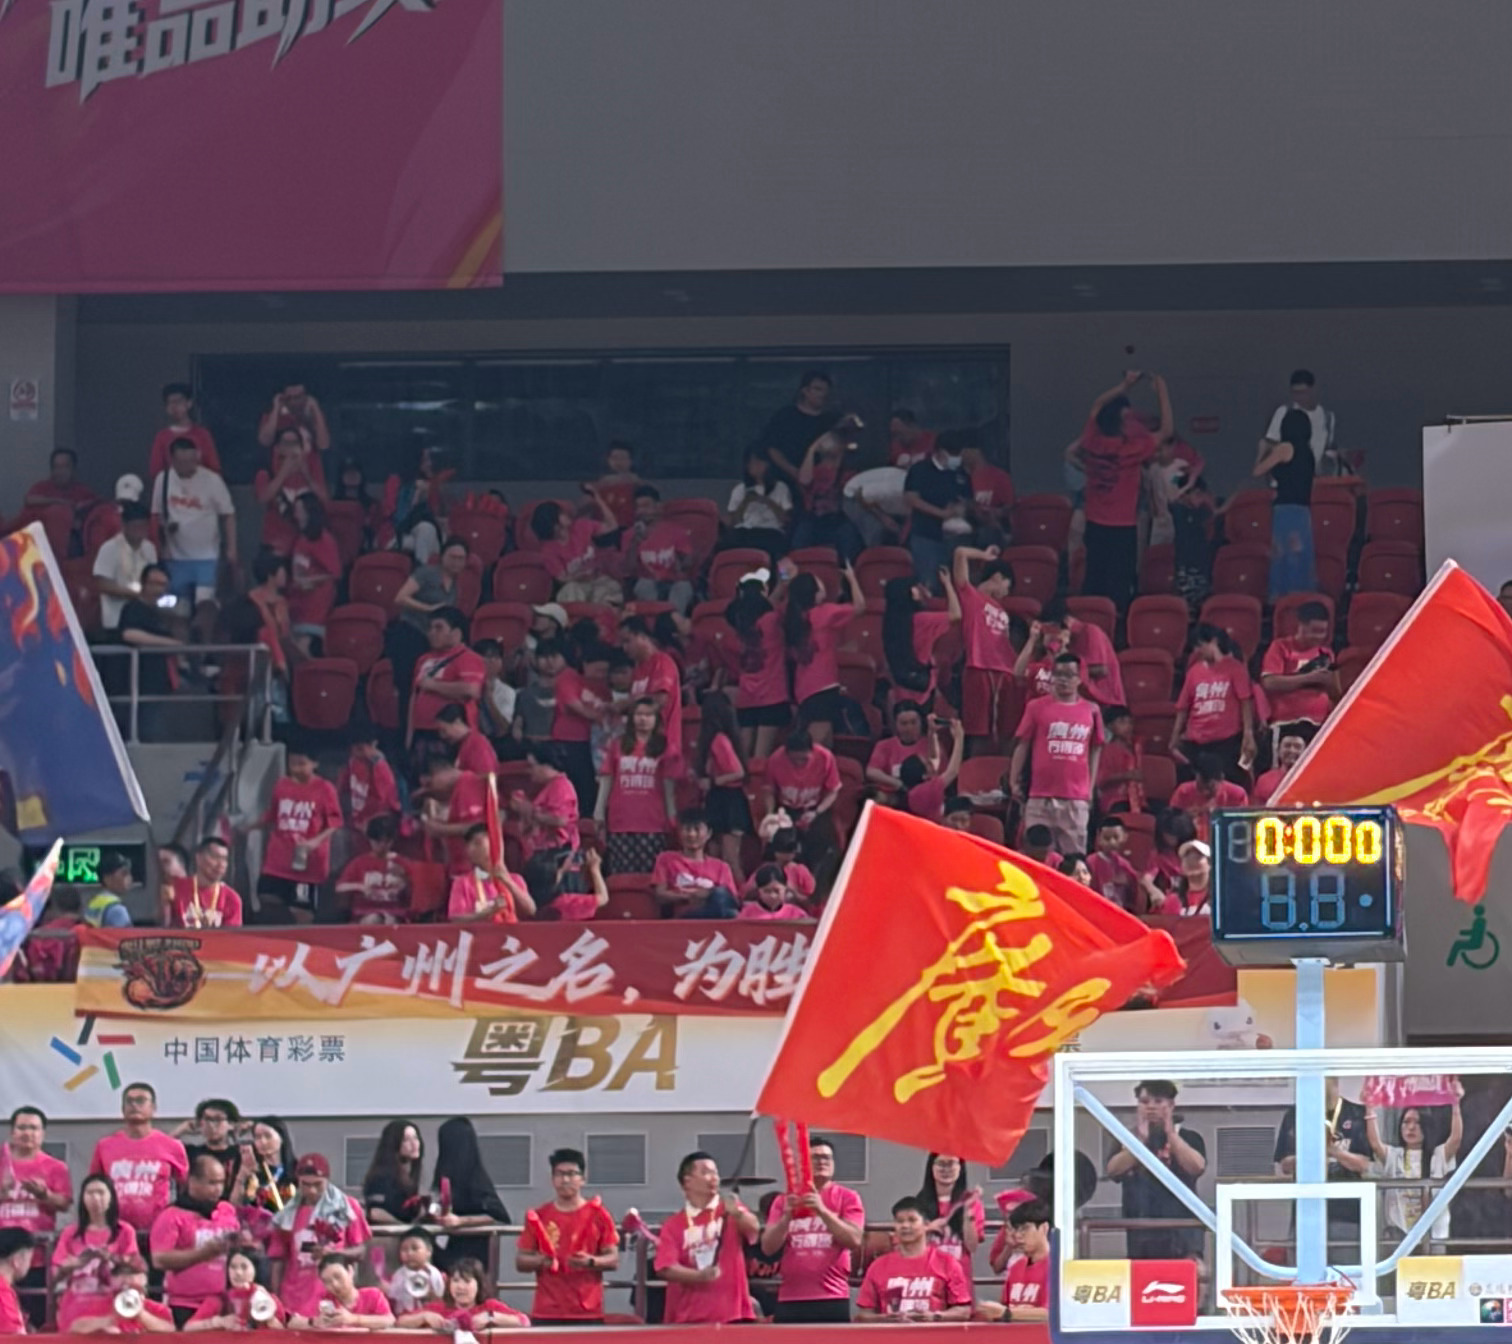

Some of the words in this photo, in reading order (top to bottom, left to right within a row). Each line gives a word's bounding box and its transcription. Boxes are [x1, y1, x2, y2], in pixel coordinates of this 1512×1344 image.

[164, 1034, 346, 1065] 中国体育彩票
[452, 1017, 680, 1097] 粤BA
[1073, 1285, 1122, 1305] 粤BA
[1406, 1282, 1457, 1301] 粤BA
